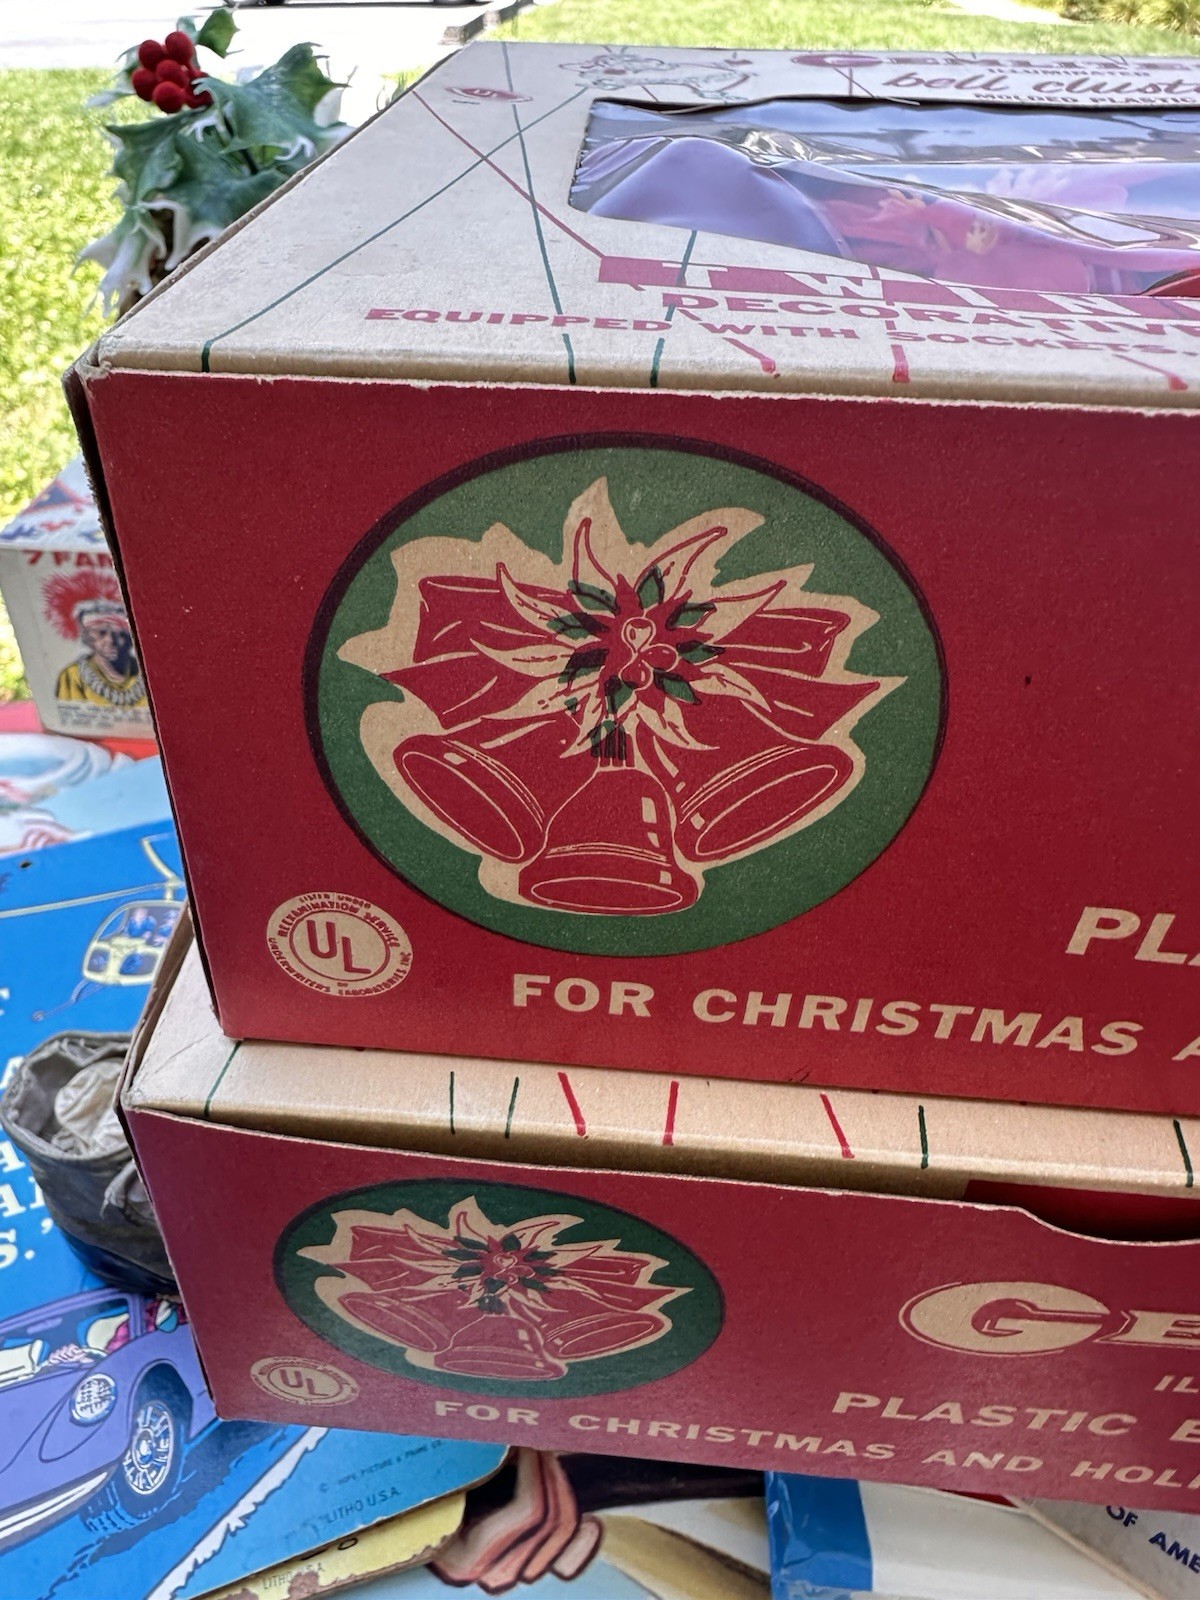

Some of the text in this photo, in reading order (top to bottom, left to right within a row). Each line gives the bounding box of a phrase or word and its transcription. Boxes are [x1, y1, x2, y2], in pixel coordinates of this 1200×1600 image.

[882, 72, 1200, 94] bell clust
[364, 308, 673, 331] EQUIPPED
[698, 322, 860, 339] WITH
[306, 919, 371, 974] UL
[1065, 906, 1200, 966] PL
[513, 974, 655, 1017] FOR
[692, 988, 1144, 1056] CHRISTMAS
[279, 1369, 330, 1397] UL
[435, 1400, 539, 1425] FOR
[568, 1415, 896, 1459] CHRISTMAS
[922, 1451, 1044, 1472] AND
[832, 1392, 1138, 1436] PLASTIC
[1106, 1504, 1138, 1527] OF
